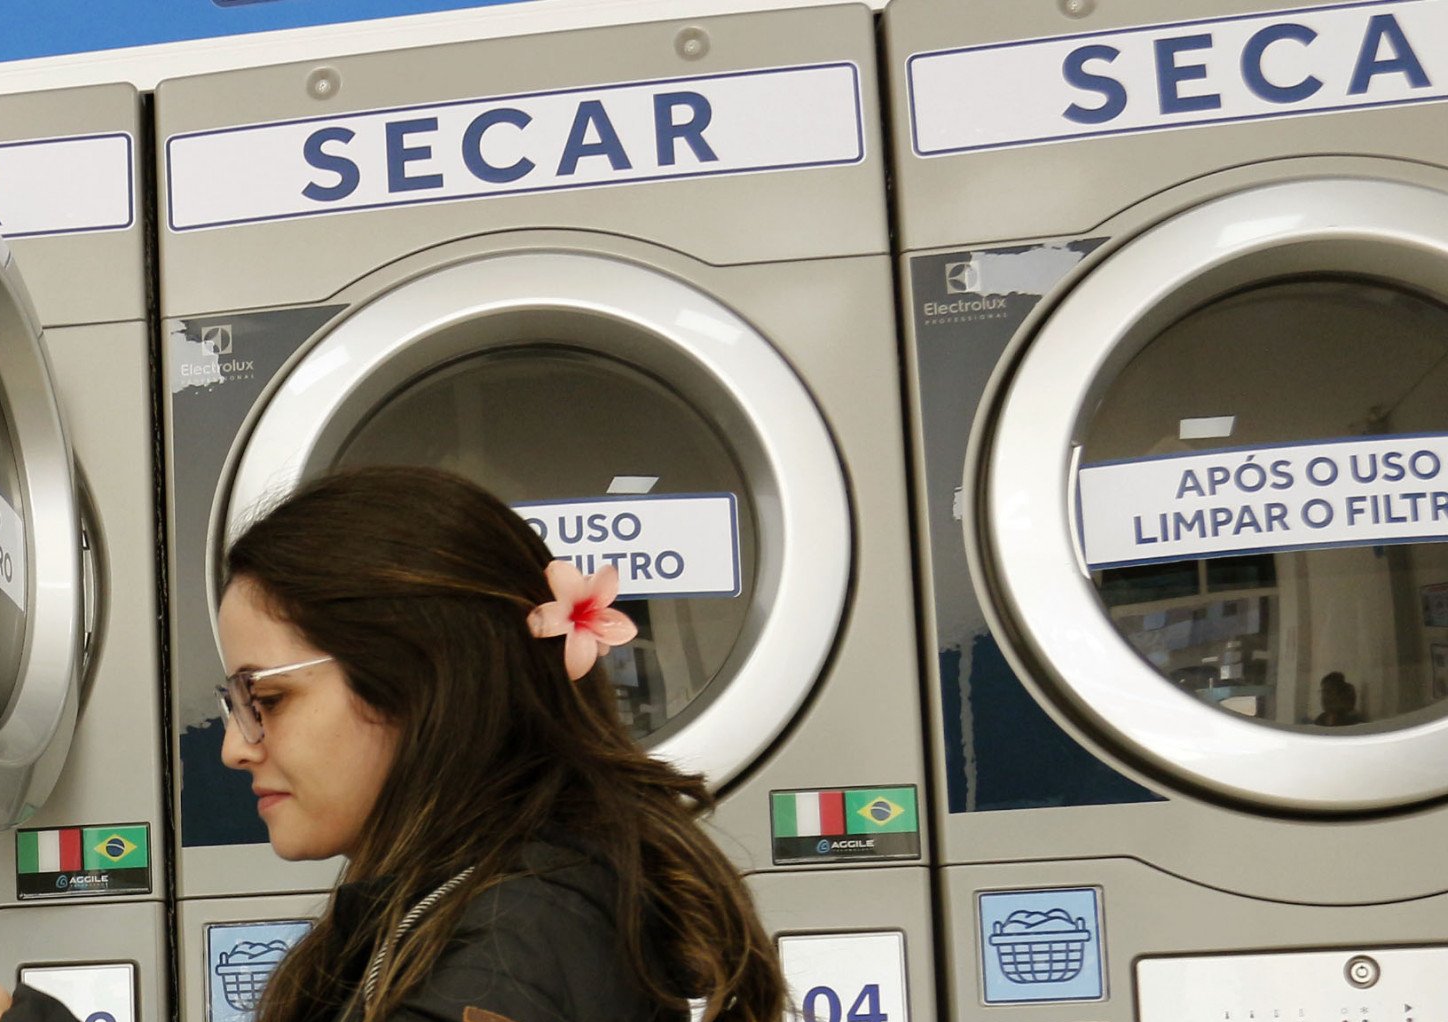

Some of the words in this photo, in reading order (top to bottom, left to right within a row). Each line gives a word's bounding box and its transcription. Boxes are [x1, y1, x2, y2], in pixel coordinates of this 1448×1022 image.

[300, 90, 720, 202] SECAR
[923, 298, 1007, 316] Electrolux
[1175, 454, 1294, 499] APÓS
[1305, 456, 1338, 487] O
[1349, 449, 1441, 484] USO
[558, 512, 642, 544] USO
[1133, 502, 1290, 545] LIMPAR
[1301, 498, 1334, 529] O
